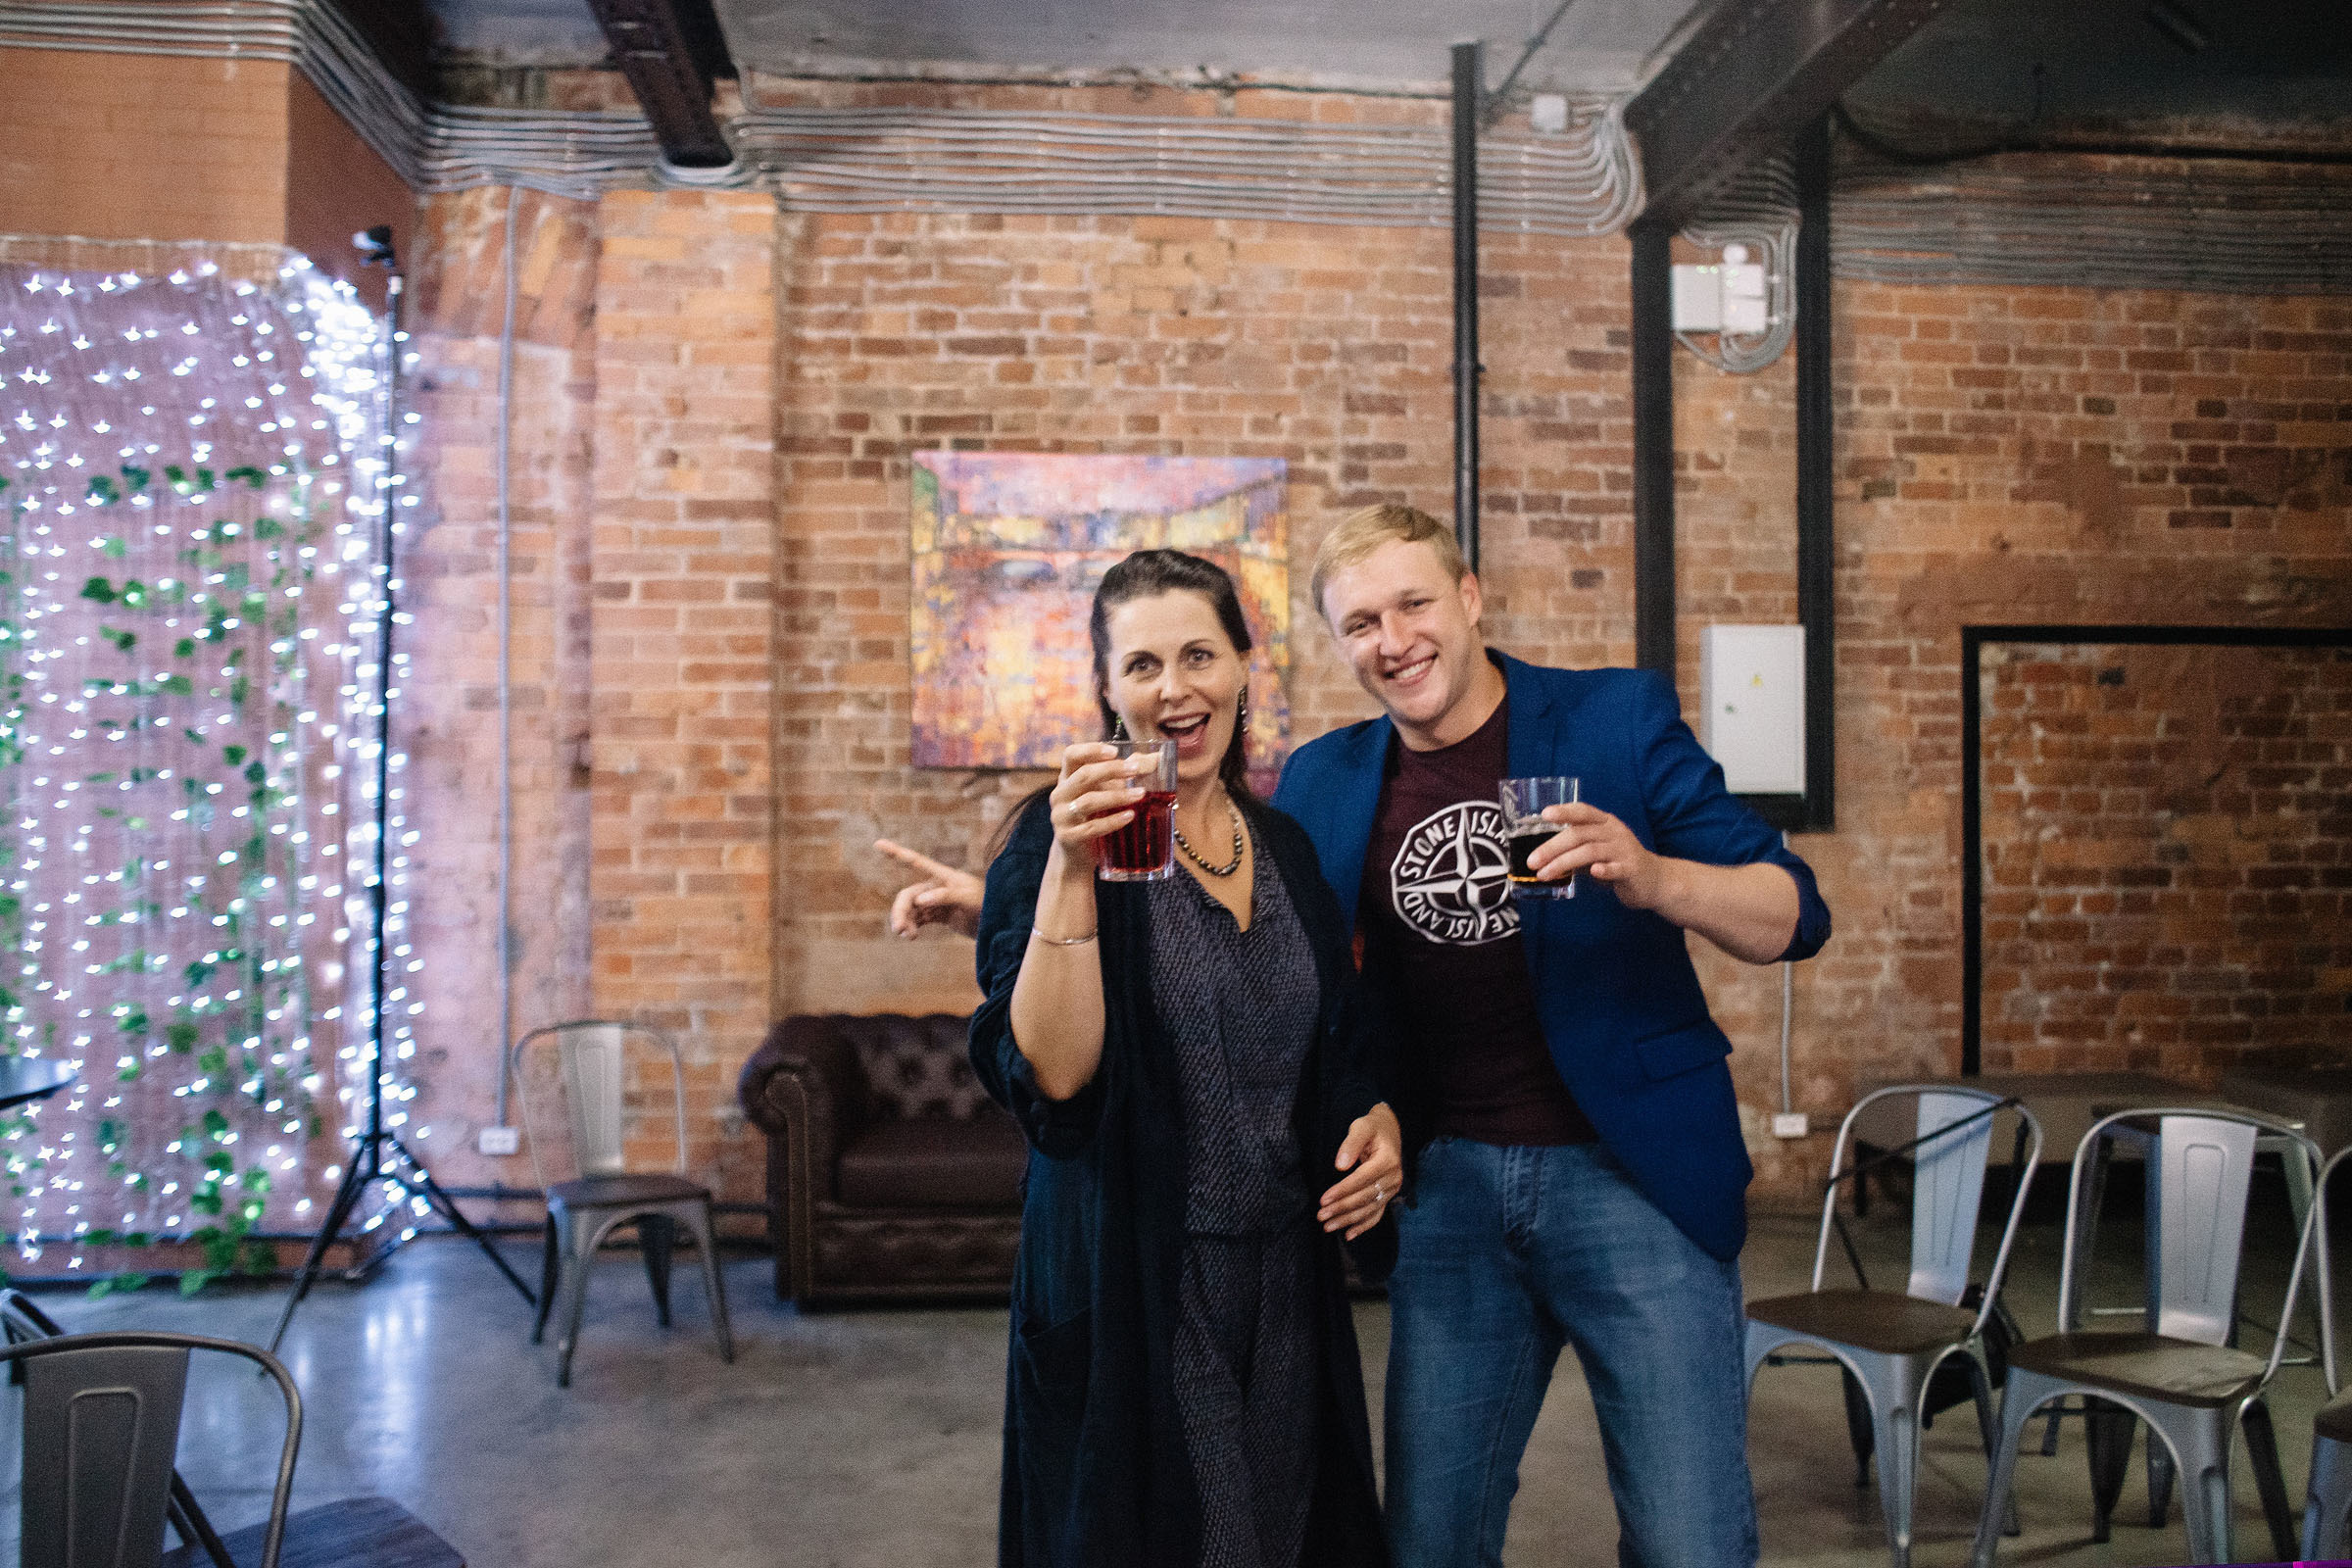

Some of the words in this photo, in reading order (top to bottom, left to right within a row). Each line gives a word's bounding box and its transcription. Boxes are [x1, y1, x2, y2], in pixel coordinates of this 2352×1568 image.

[1400, 816, 1456, 878] STONE
[1471, 810, 1509, 847] ISLA
[1403, 893, 1474, 939] ISLAND
